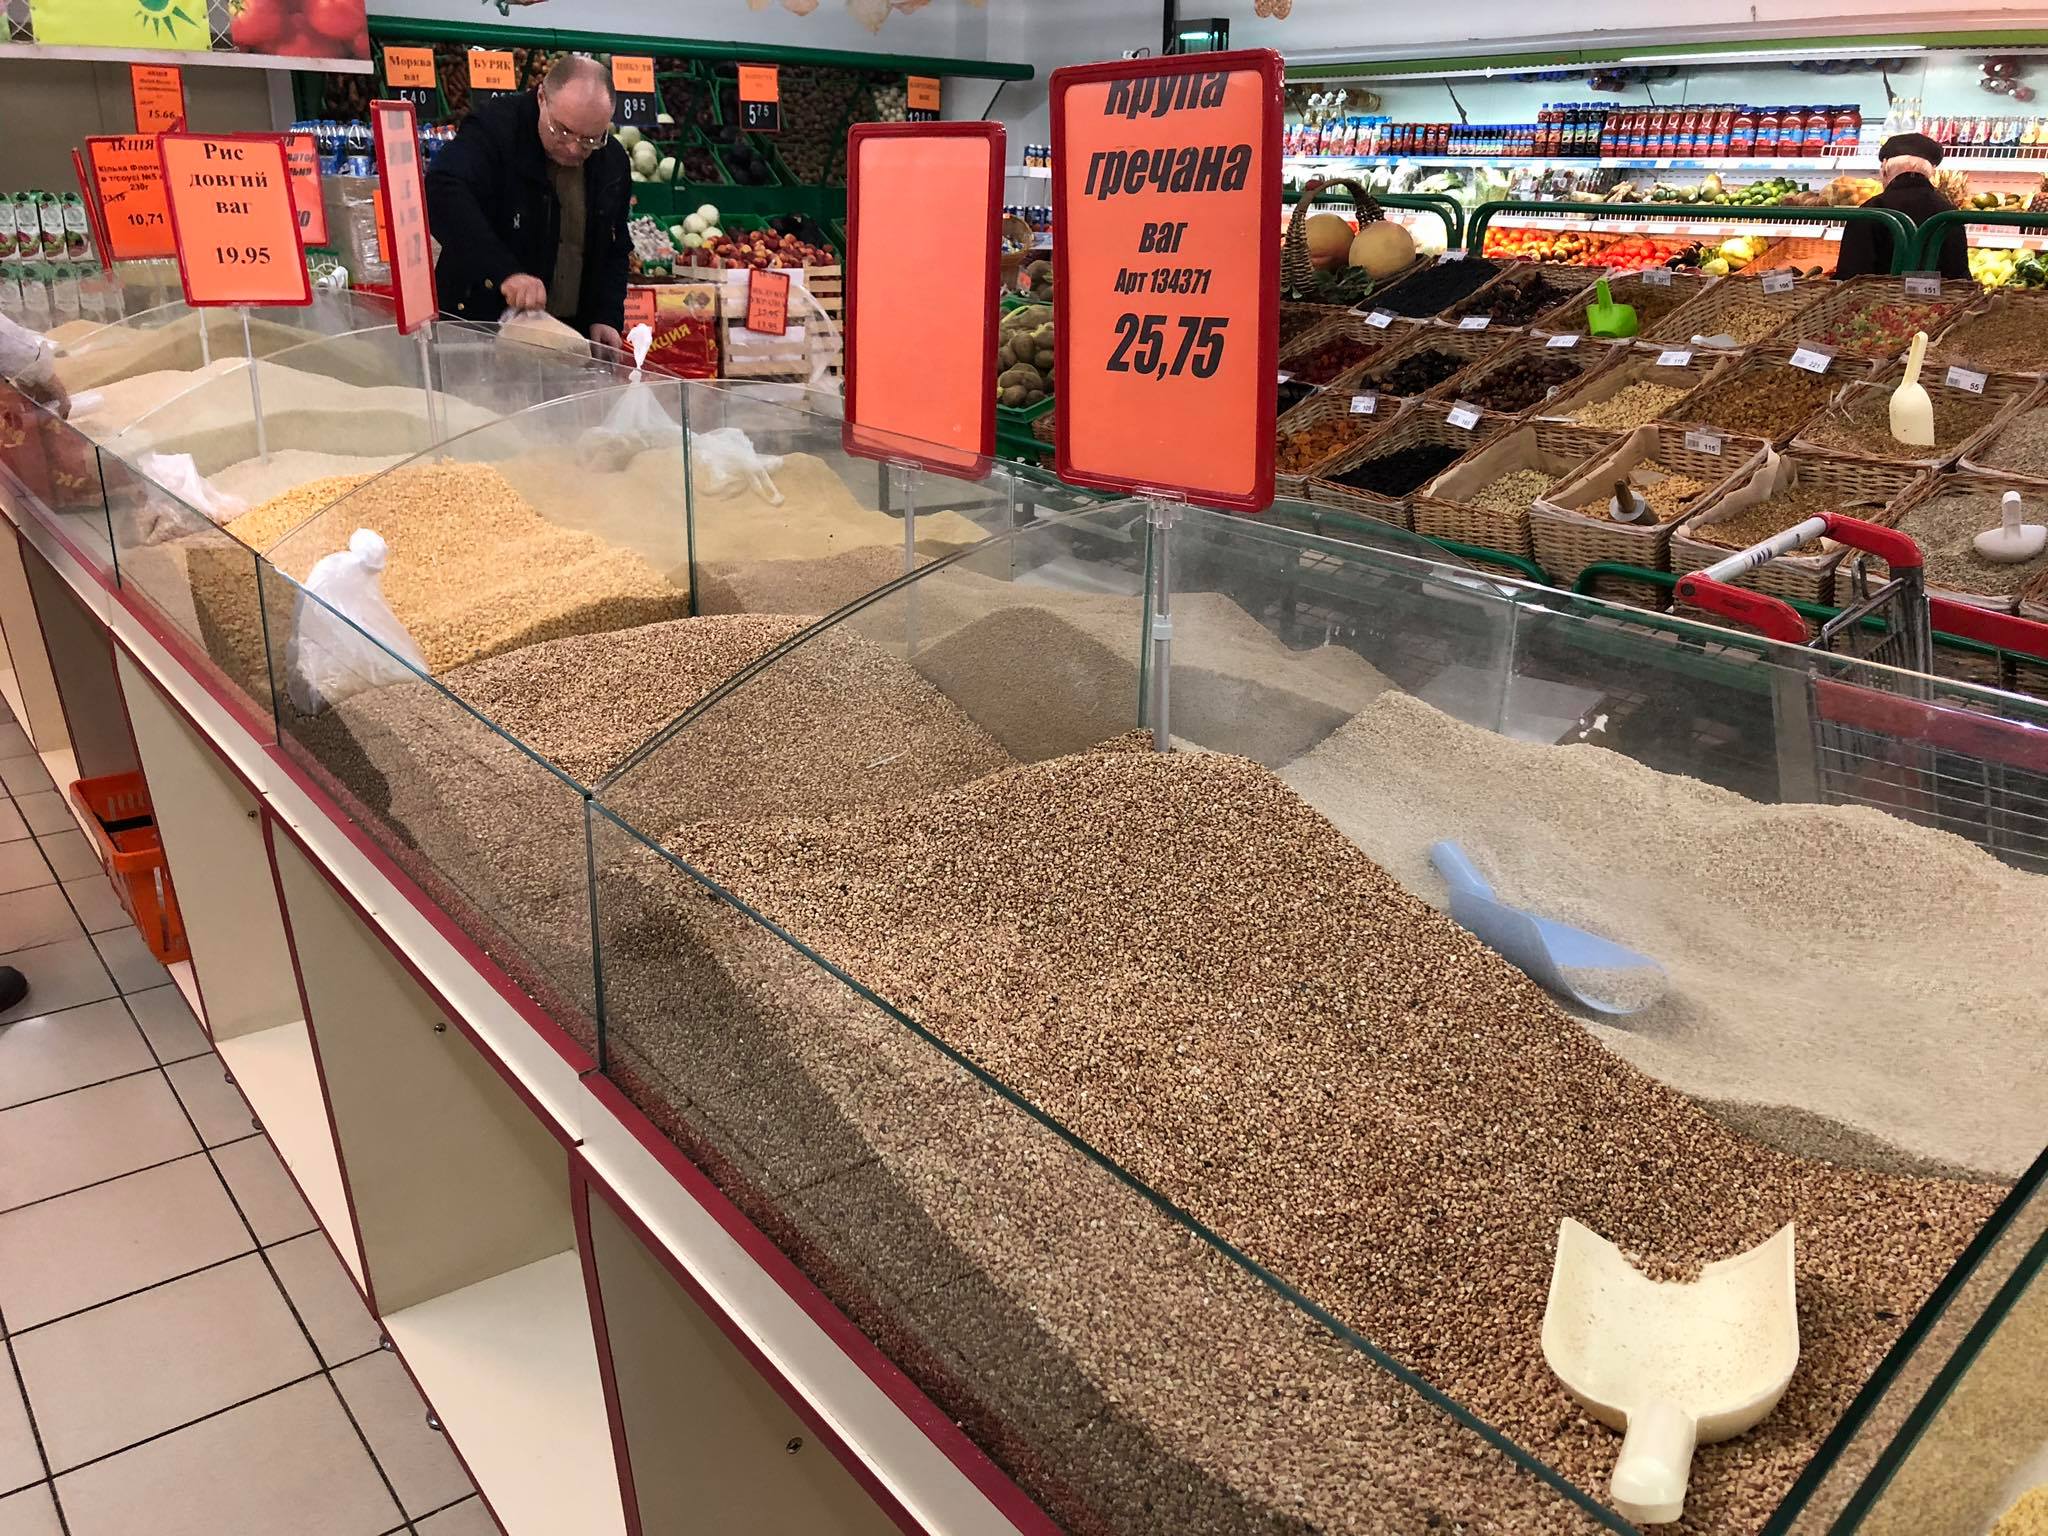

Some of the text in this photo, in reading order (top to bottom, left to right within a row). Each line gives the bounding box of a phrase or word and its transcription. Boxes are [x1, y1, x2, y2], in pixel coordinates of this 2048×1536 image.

[473, 58, 511, 71] БУРЯК
[148, 109, 176, 119] 15.66
[203, 143, 244, 160] Рис
[189, 171, 268, 188] довгий
[1084, 144, 1253, 200] гречана
[215, 201, 253, 214] ваг
[127, 213, 164, 226] 10,71
[1138, 222, 1189, 253] ваг
[216, 246, 271, 264] 19.95
[1114, 268, 1212, 295] Арт 134371
[1923, 286, 1936, 294] 151
[1106, 313, 1230, 381] 25,75
[1970, 382, 1980, 391] 55
